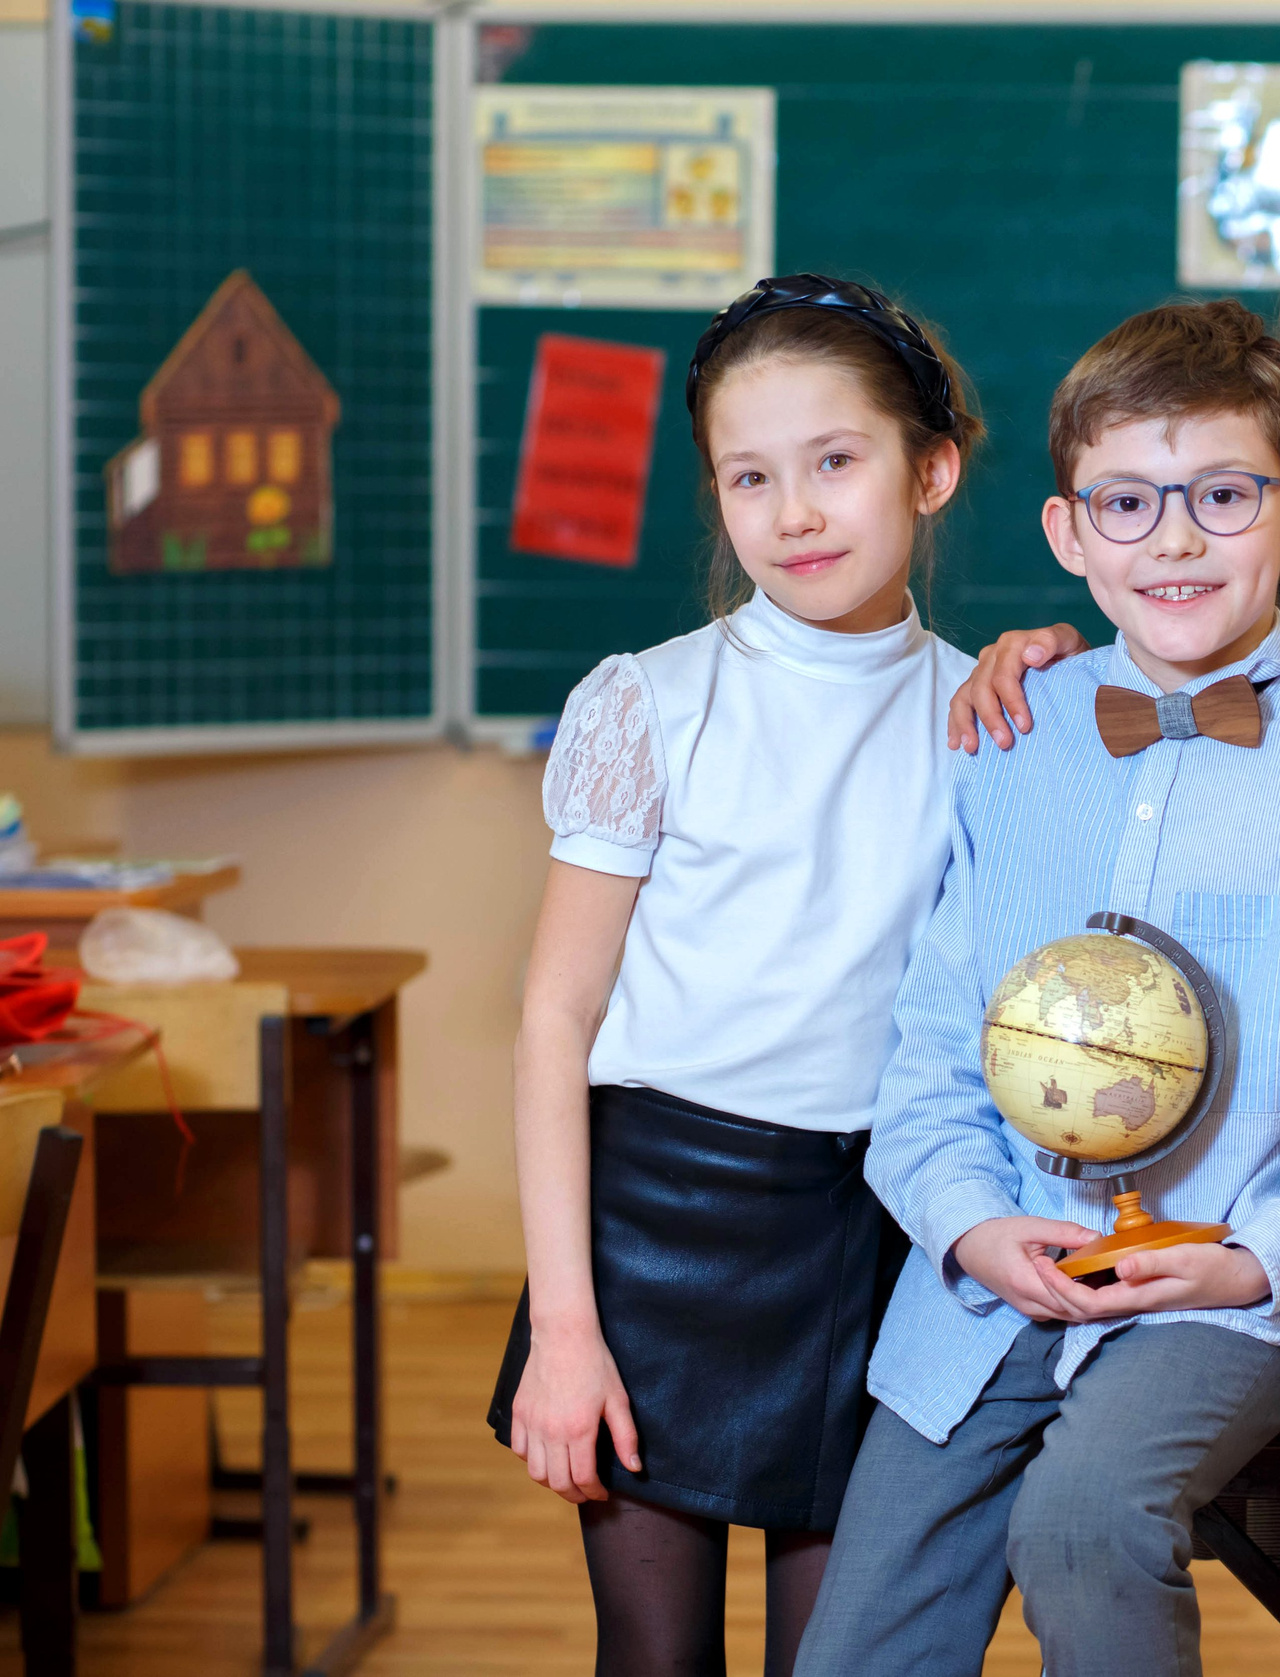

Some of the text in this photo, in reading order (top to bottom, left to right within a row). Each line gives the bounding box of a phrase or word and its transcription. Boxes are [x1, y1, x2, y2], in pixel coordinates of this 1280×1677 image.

[1008, 1048, 1065, 1066] INDIAN OCEAN
[1109, 1092, 1146, 1103] AUSTRALIA
